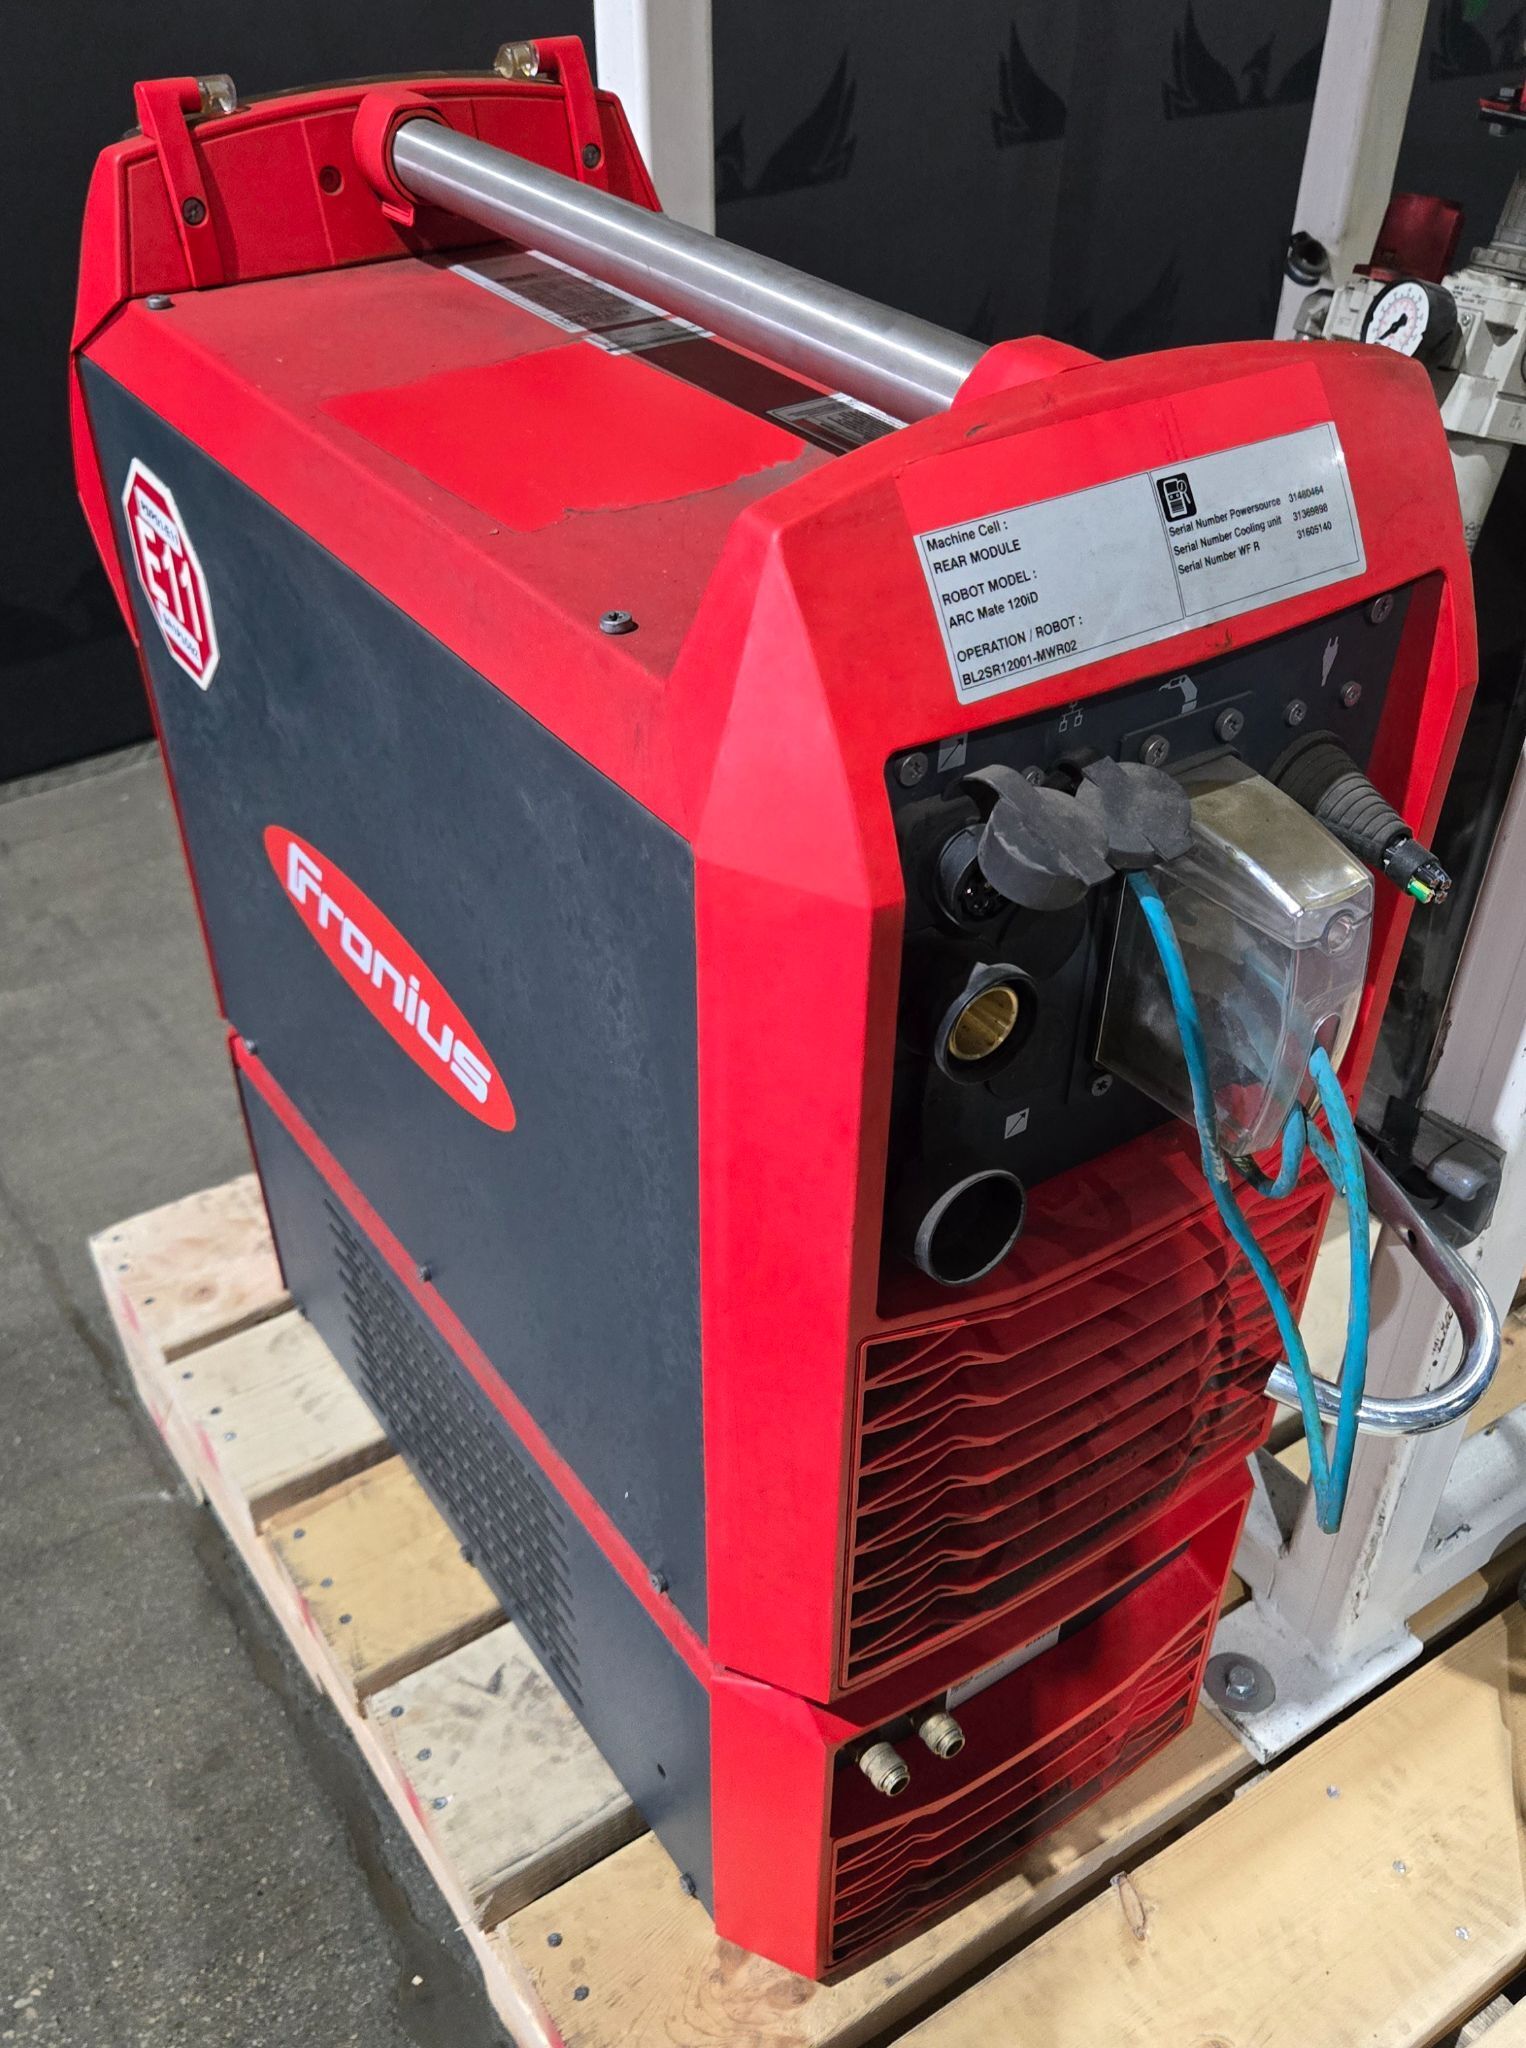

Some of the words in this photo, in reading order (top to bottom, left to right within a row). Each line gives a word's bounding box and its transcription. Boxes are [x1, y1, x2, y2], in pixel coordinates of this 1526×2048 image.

[926, 530, 976, 552] Machine
[978, 520, 1000, 536] Cell
[1169, 520, 1194, 537] Serial
[1196, 512, 1228, 529] Number
[1230, 497, 1281, 520] Powersource
[1174, 540, 1198, 556] Serial
[1200, 531, 1232, 548] Number
[1234, 520, 1266, 538] Cooling
[1268, 516, 1282, 528] unit
[933, 555, 968, 574] REAR
[970, 538, 1022, 564] MODULE
[1178, 558, 1203, 575] Serial
[1204, 550, 1236, 566] Number
[1238, 544, 1251, 556] WF
[942, 583, 984, 606] ROBOT
[988, 570, 1031, 592] MODEL
[948, 610, 975, 629] ARC
[977, 602, 1005, 620] Mate
[1008, 591, 1039, 611] 120iD
[957, 632, 1026, 662] OPERATION
[1035, 616, 1076, 638] ROBOT
[962, 640, 1078, 686] BL2SR12001-MWR02
[288, 842, 491, 1104] Fronius
